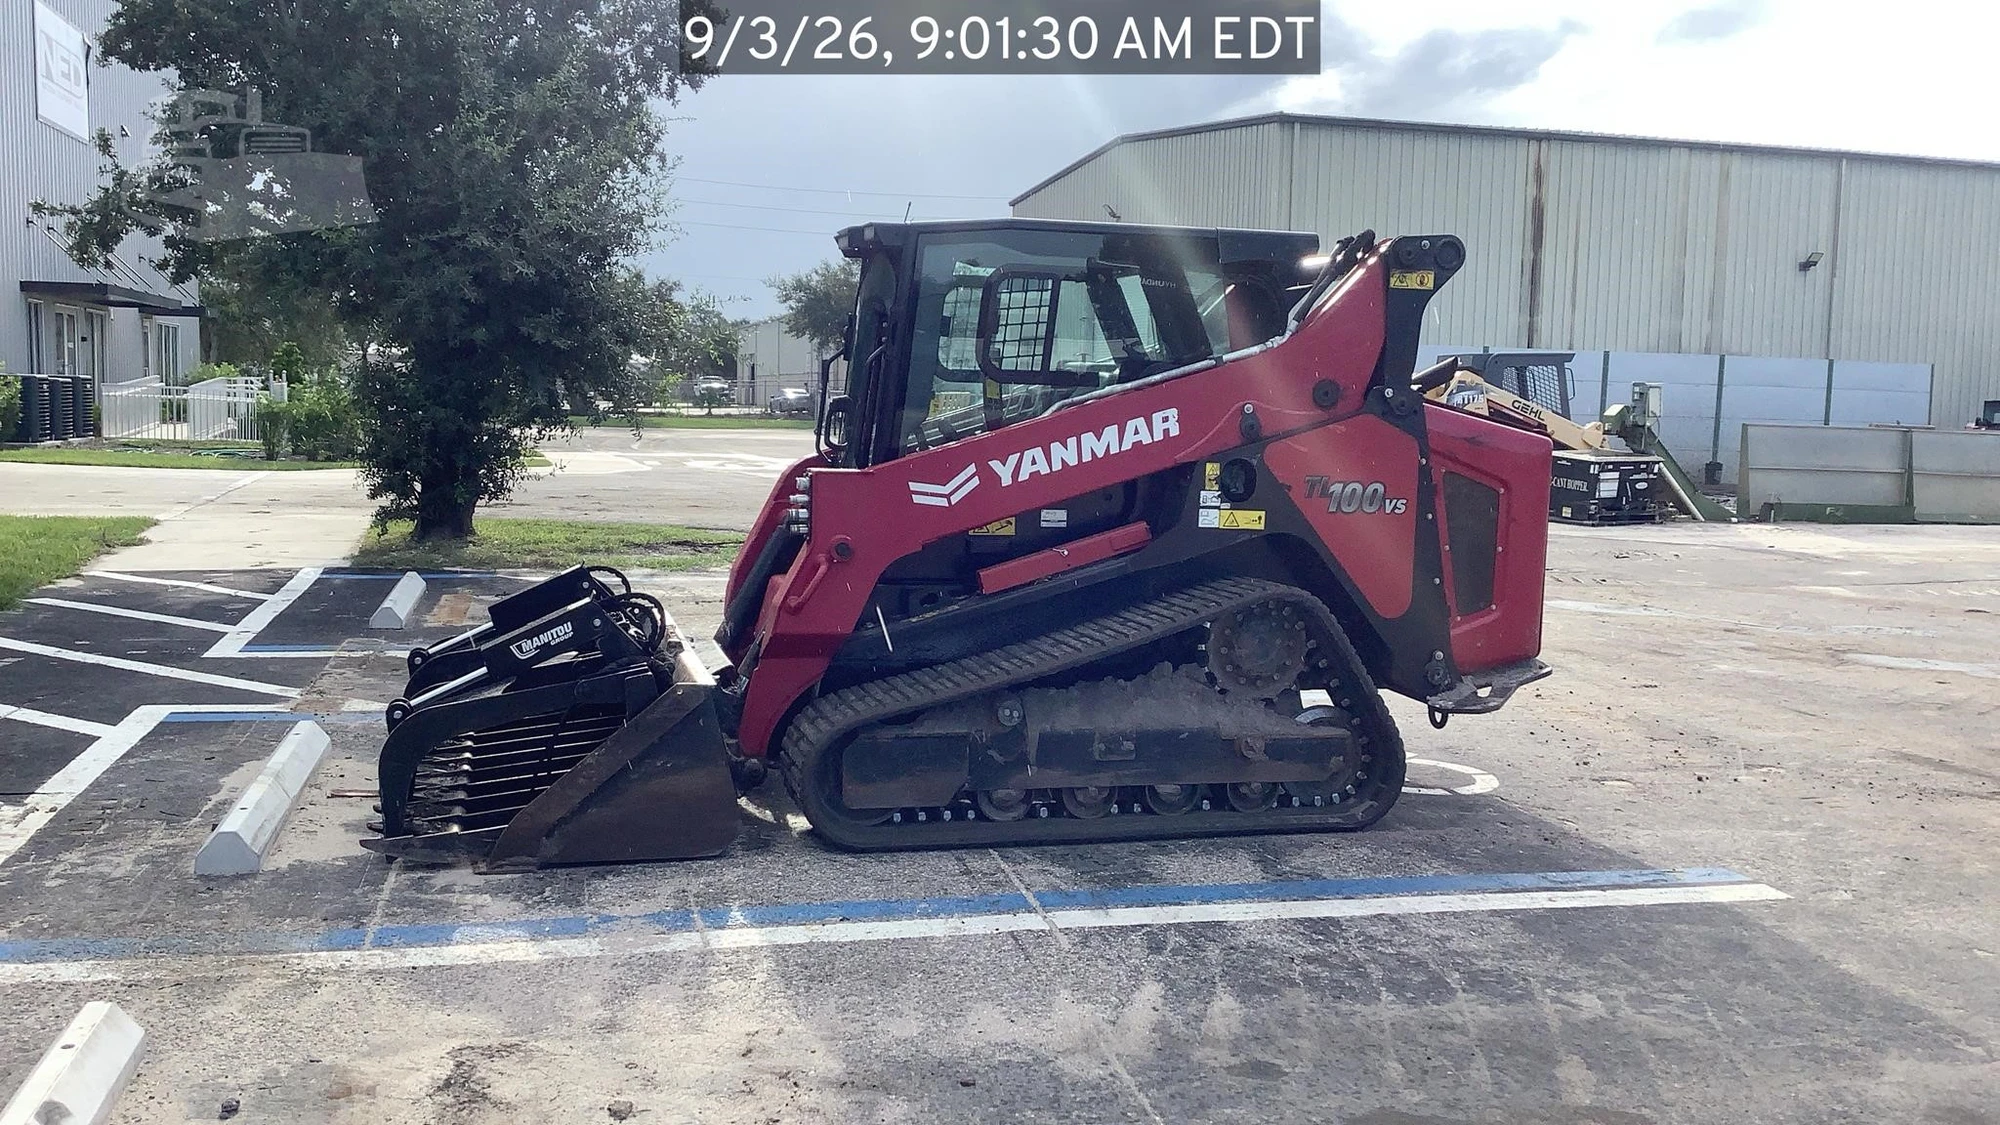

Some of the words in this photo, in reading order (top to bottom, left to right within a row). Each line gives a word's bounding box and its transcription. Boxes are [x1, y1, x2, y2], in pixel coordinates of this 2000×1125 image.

[40, 31, 84, 97] NED
[1512, 399, 1546, 421] GEHL
[988, 407, 1180, 487] YANMAR
[521, 621, 573, 653] MANITOU
[550, 631, 574, 646] GROUP
